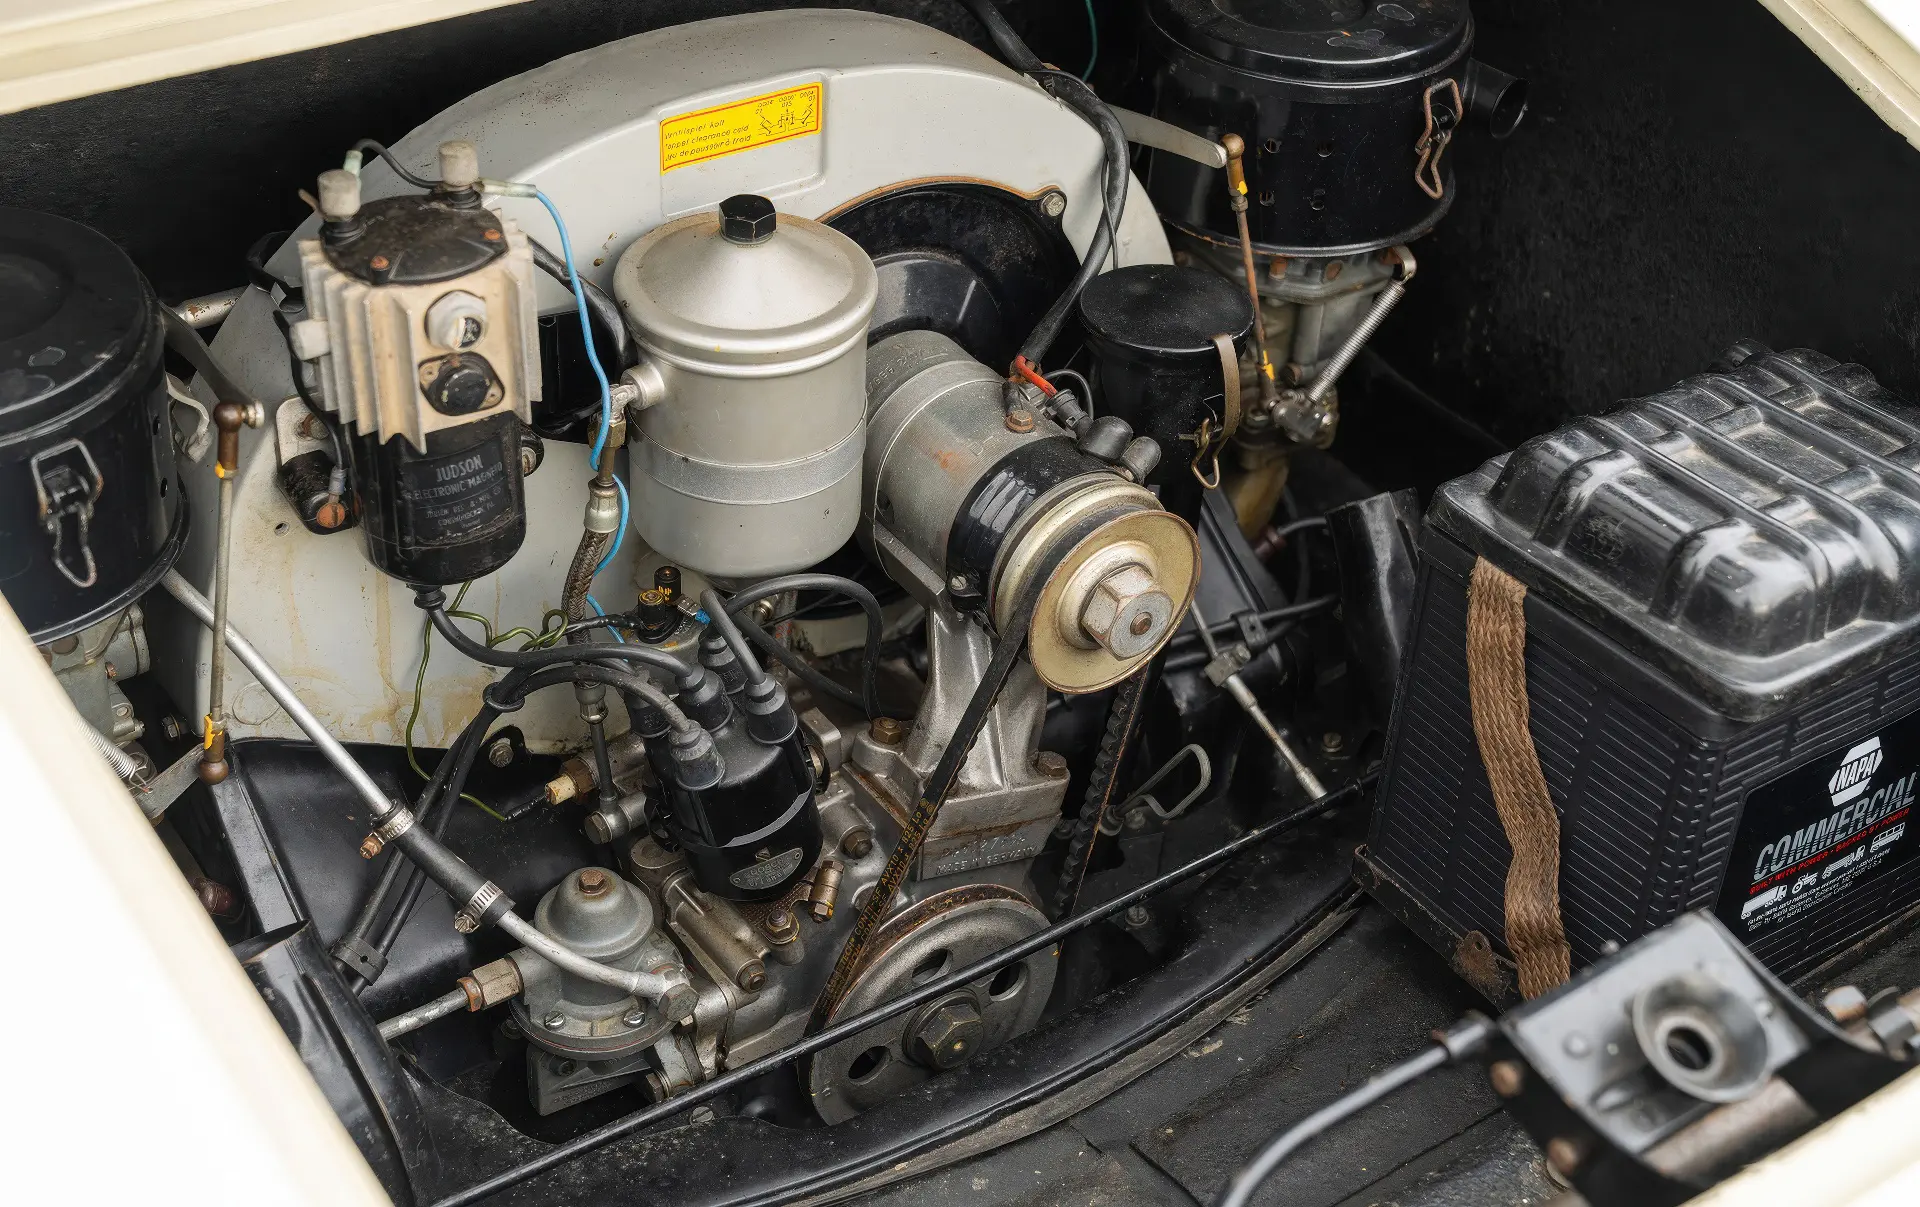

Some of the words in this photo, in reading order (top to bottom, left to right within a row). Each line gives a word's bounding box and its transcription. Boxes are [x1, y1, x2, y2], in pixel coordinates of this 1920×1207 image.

[414, 479, 466, 500] ELECTRONIC
[468, 462, 503, 488] MAGNETO
[436, 454, 483, 482] JUDSON
[1835, 752, 1878, 792] NAPA
[1753, 772, 1917, 880] COMMERCIAL
[1749, 878, 1773, 894] BUILT
[1774, 867, 1796, 882] WITH
[1796, 852, 1829, 871] POWER
[1835, 830, 1867, 852] BACKED
[1868, 824, 1879, 835] BY
[1881, 808, 1910, 825] POWER
